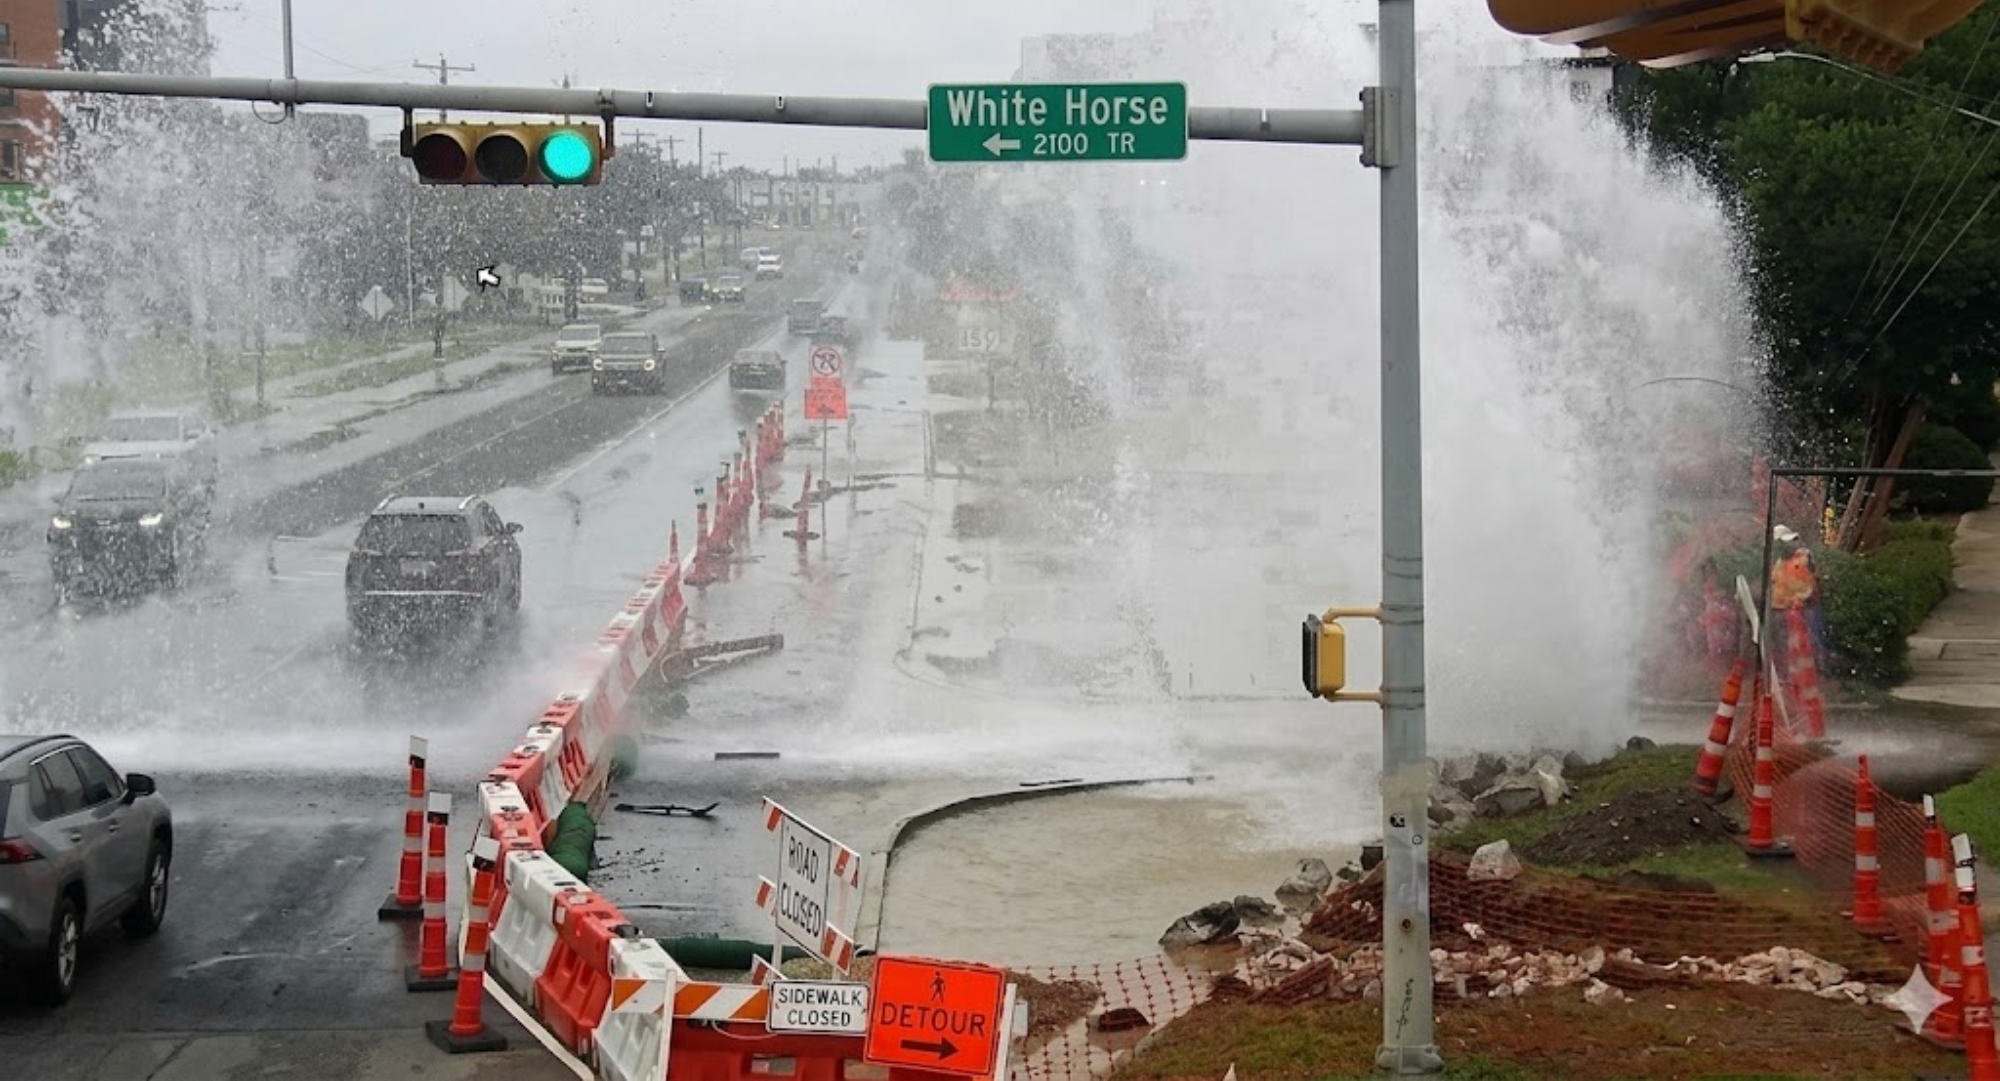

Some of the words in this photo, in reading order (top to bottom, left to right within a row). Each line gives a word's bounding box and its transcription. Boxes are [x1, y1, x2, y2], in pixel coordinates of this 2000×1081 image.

[947, 90, 1047, 127] White
[1066, 88, 1168, 125] Horse
[1034, 133, 1089, 155] 2100
[1108, 132, 1135, 154] TR
[788, 835, 819, 884] ROAD
[781, 881, 821, 938] CLOSED
[779, 988, 862, 1006] SIDEWALK
[787, 1009, 851, 1027] CLOSED
[880, 1002, 987, 1036] DETOUR
